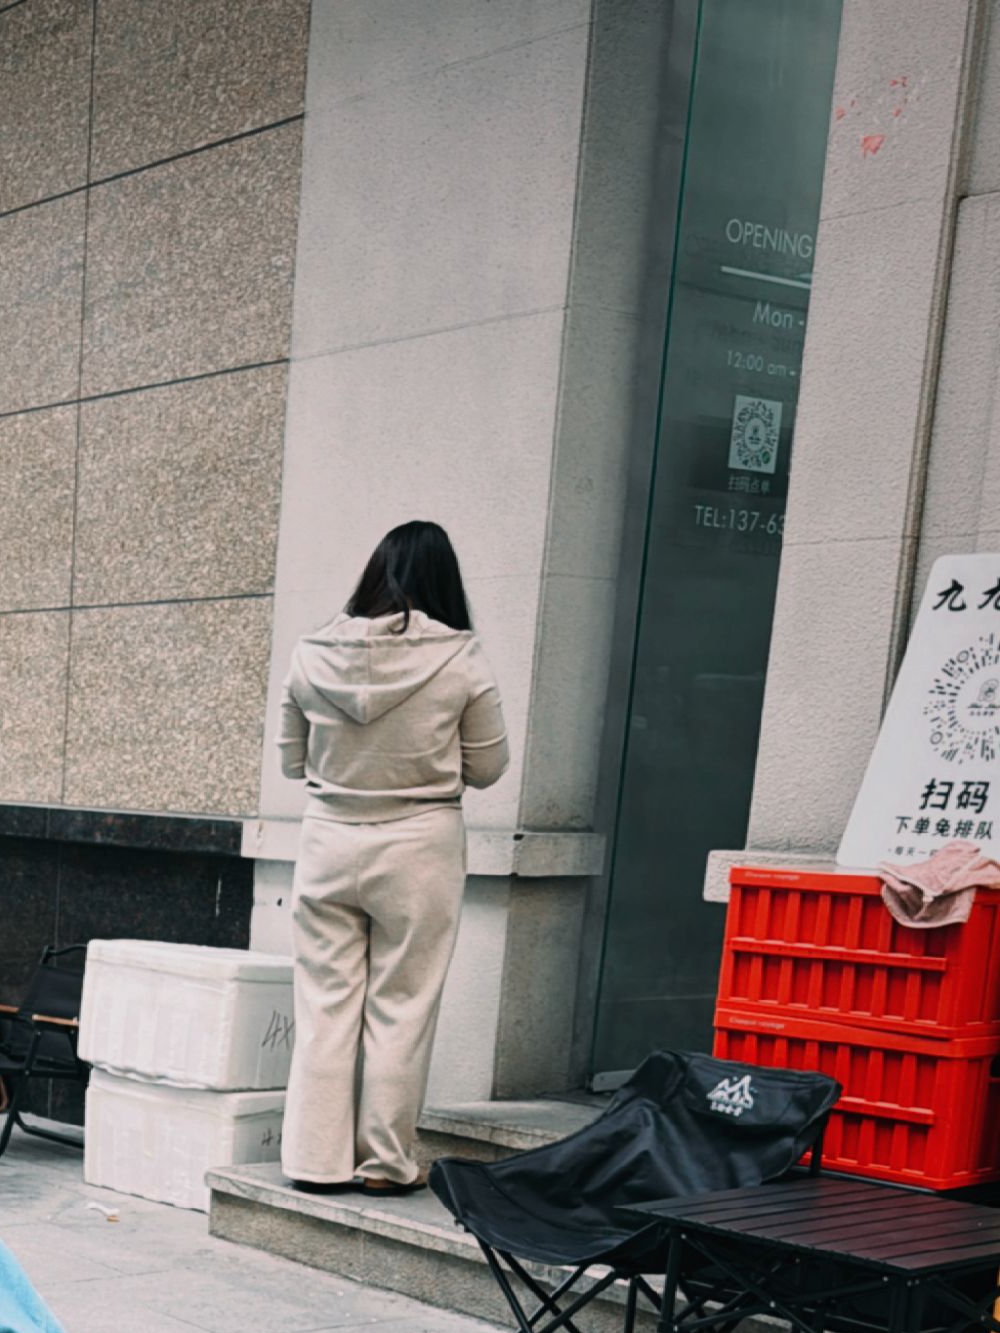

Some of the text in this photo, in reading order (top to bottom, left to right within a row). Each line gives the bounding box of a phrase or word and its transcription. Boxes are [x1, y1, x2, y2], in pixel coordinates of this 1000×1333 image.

[725, 218, 813, 258] OPENING
[752, 301, 794, 329] Mon
[727, 350, 764, 373] 12:00
[767, 362, 787, 376] am
[919, 777, 990, 814] 扫码
[894, 815, 994, 840] 下单免排队
